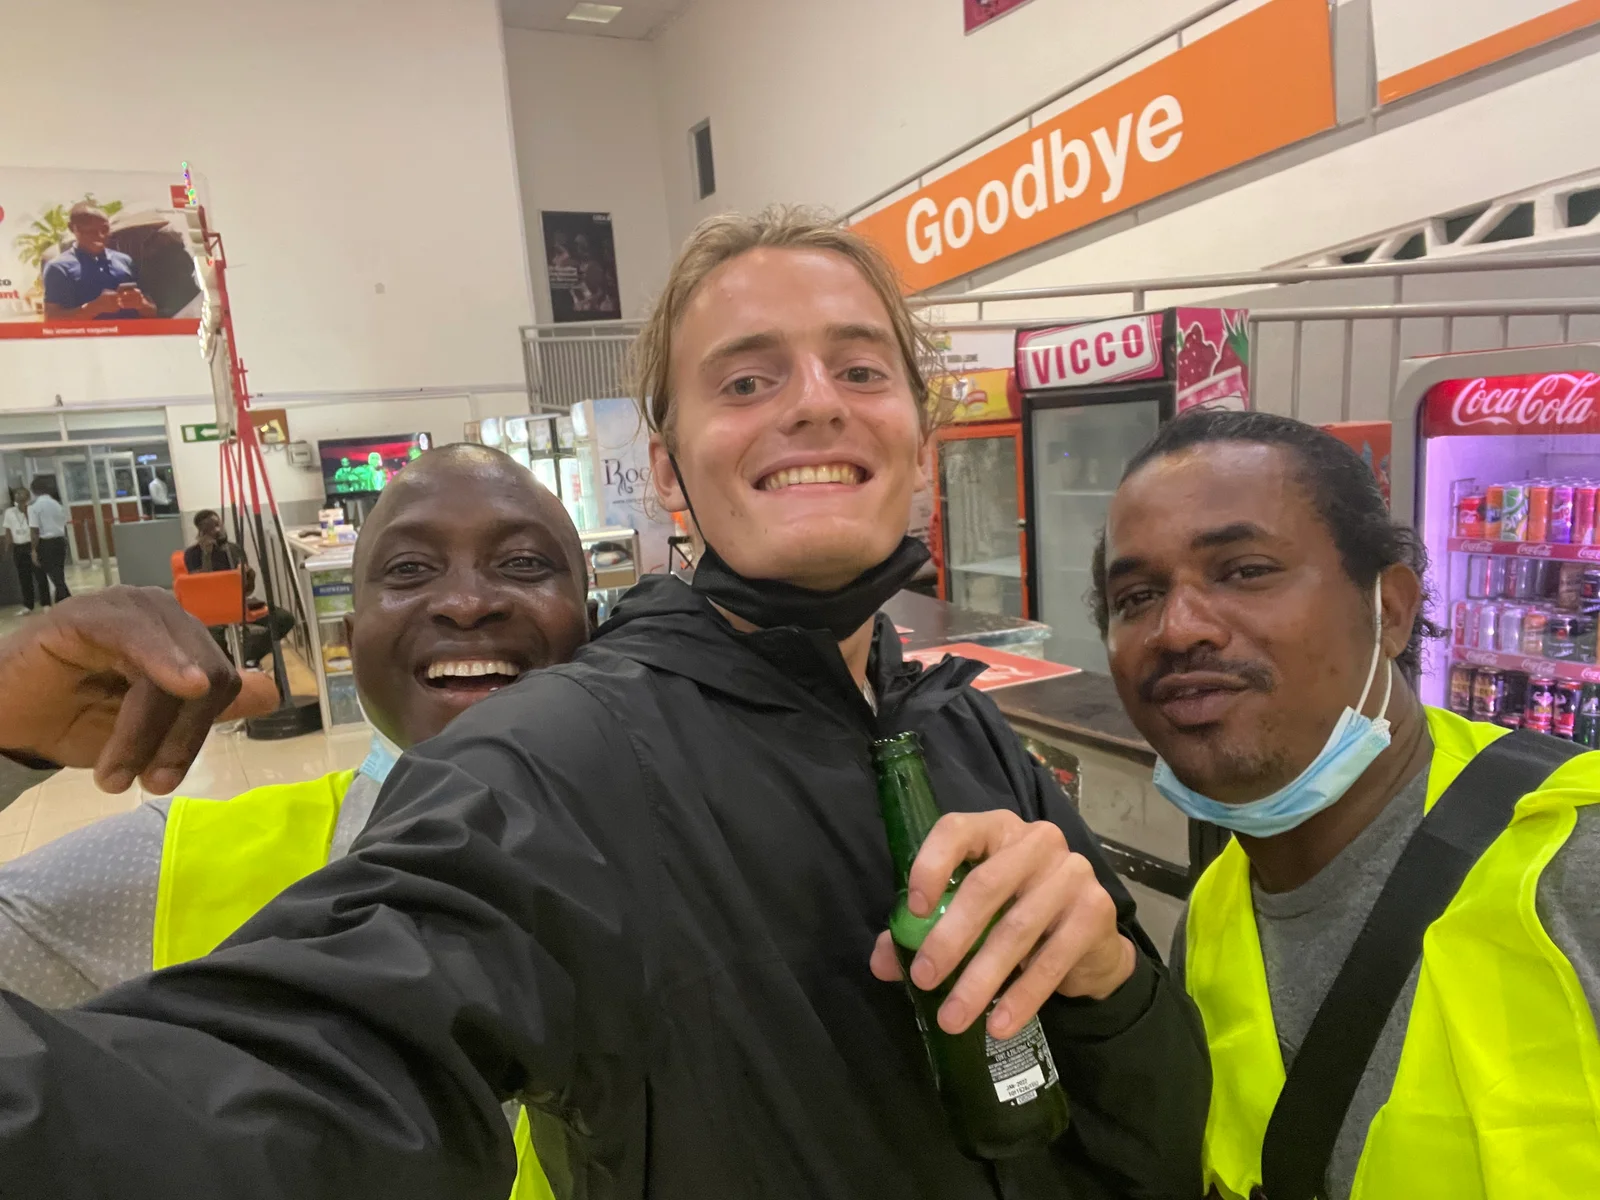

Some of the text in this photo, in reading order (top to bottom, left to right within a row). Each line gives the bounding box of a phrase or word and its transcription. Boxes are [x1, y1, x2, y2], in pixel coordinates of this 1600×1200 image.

[905, 93, 1184, 265] Goodbye
[1031, 323, 1145, 385] VICCO
[1451, 372, 1600, 426] Coca-Cola
[604, 458, 650, 496] Roc
[1460, 540, 1493, 553] Coca-Cola
[1516, 543, 1554, 557] Coca-Cola
[1465, 651, 1499, 665] Coca-Cola
[1521, 658, 1557, 675] Coca-Cola
